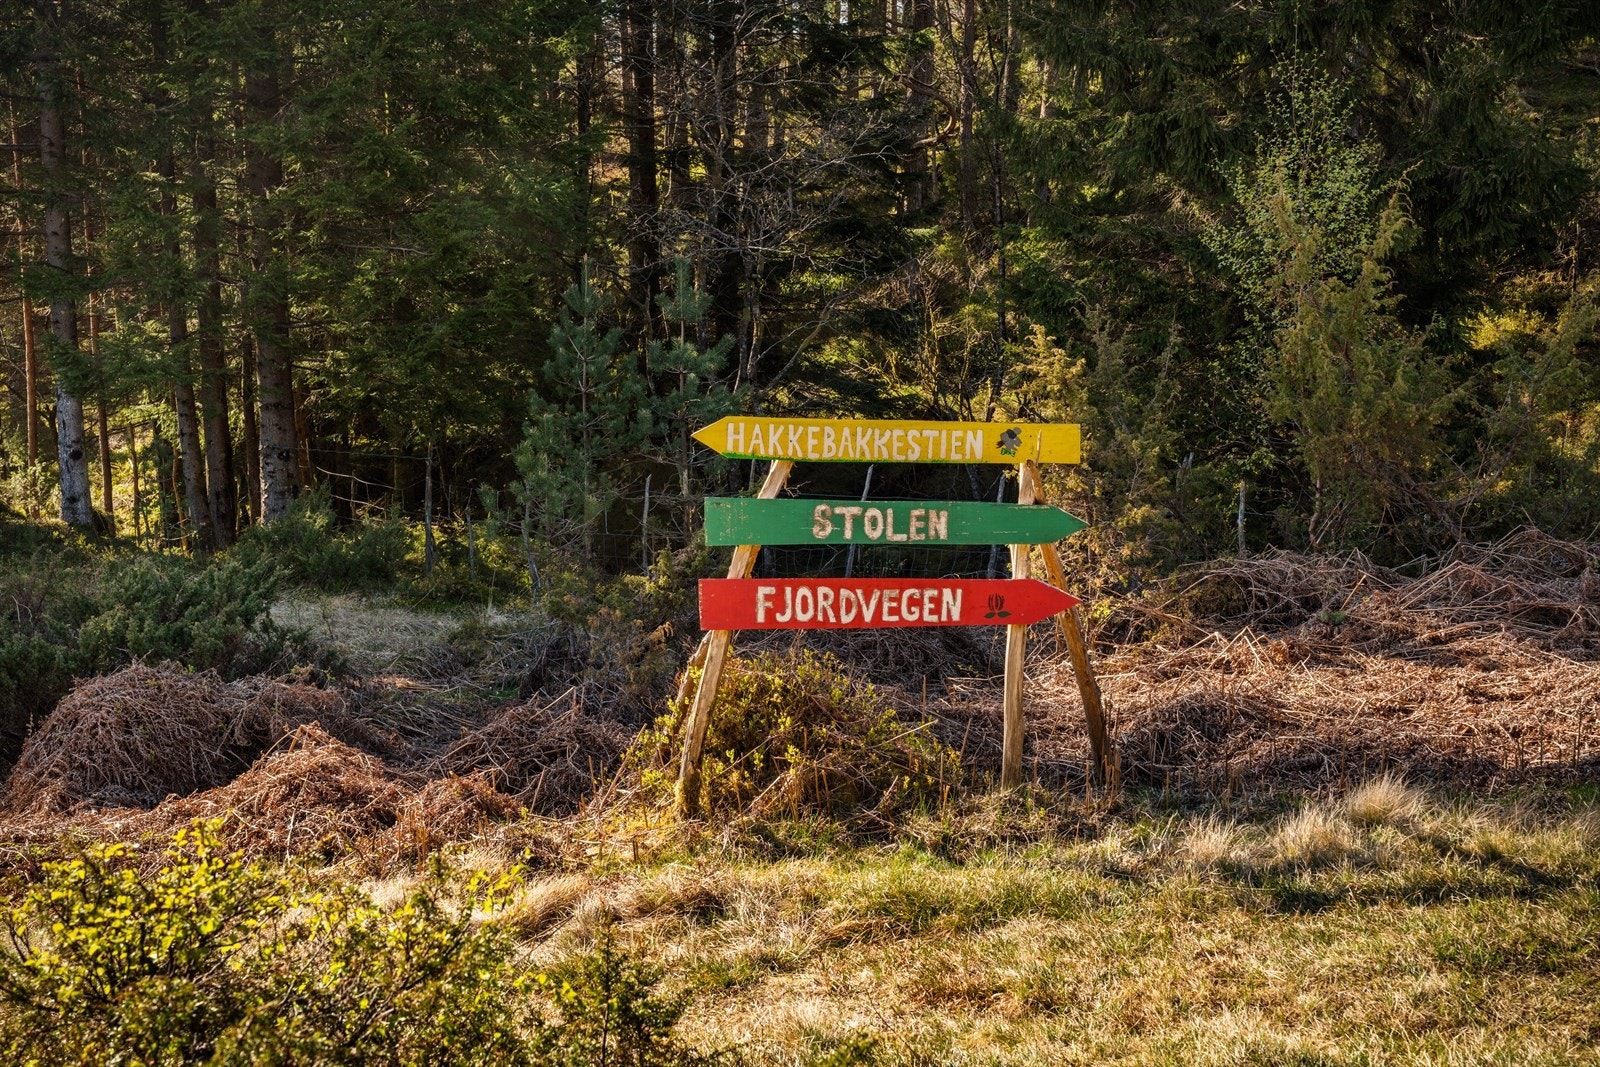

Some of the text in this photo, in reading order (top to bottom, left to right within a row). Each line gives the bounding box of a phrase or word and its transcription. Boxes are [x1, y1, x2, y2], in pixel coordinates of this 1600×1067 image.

[726, 422, 983, 461] HAKKEBAKKESTIEN
[812, 503, 949, 542] STOLEN
[755, 586, 963, 624] FJORDVEGEN
